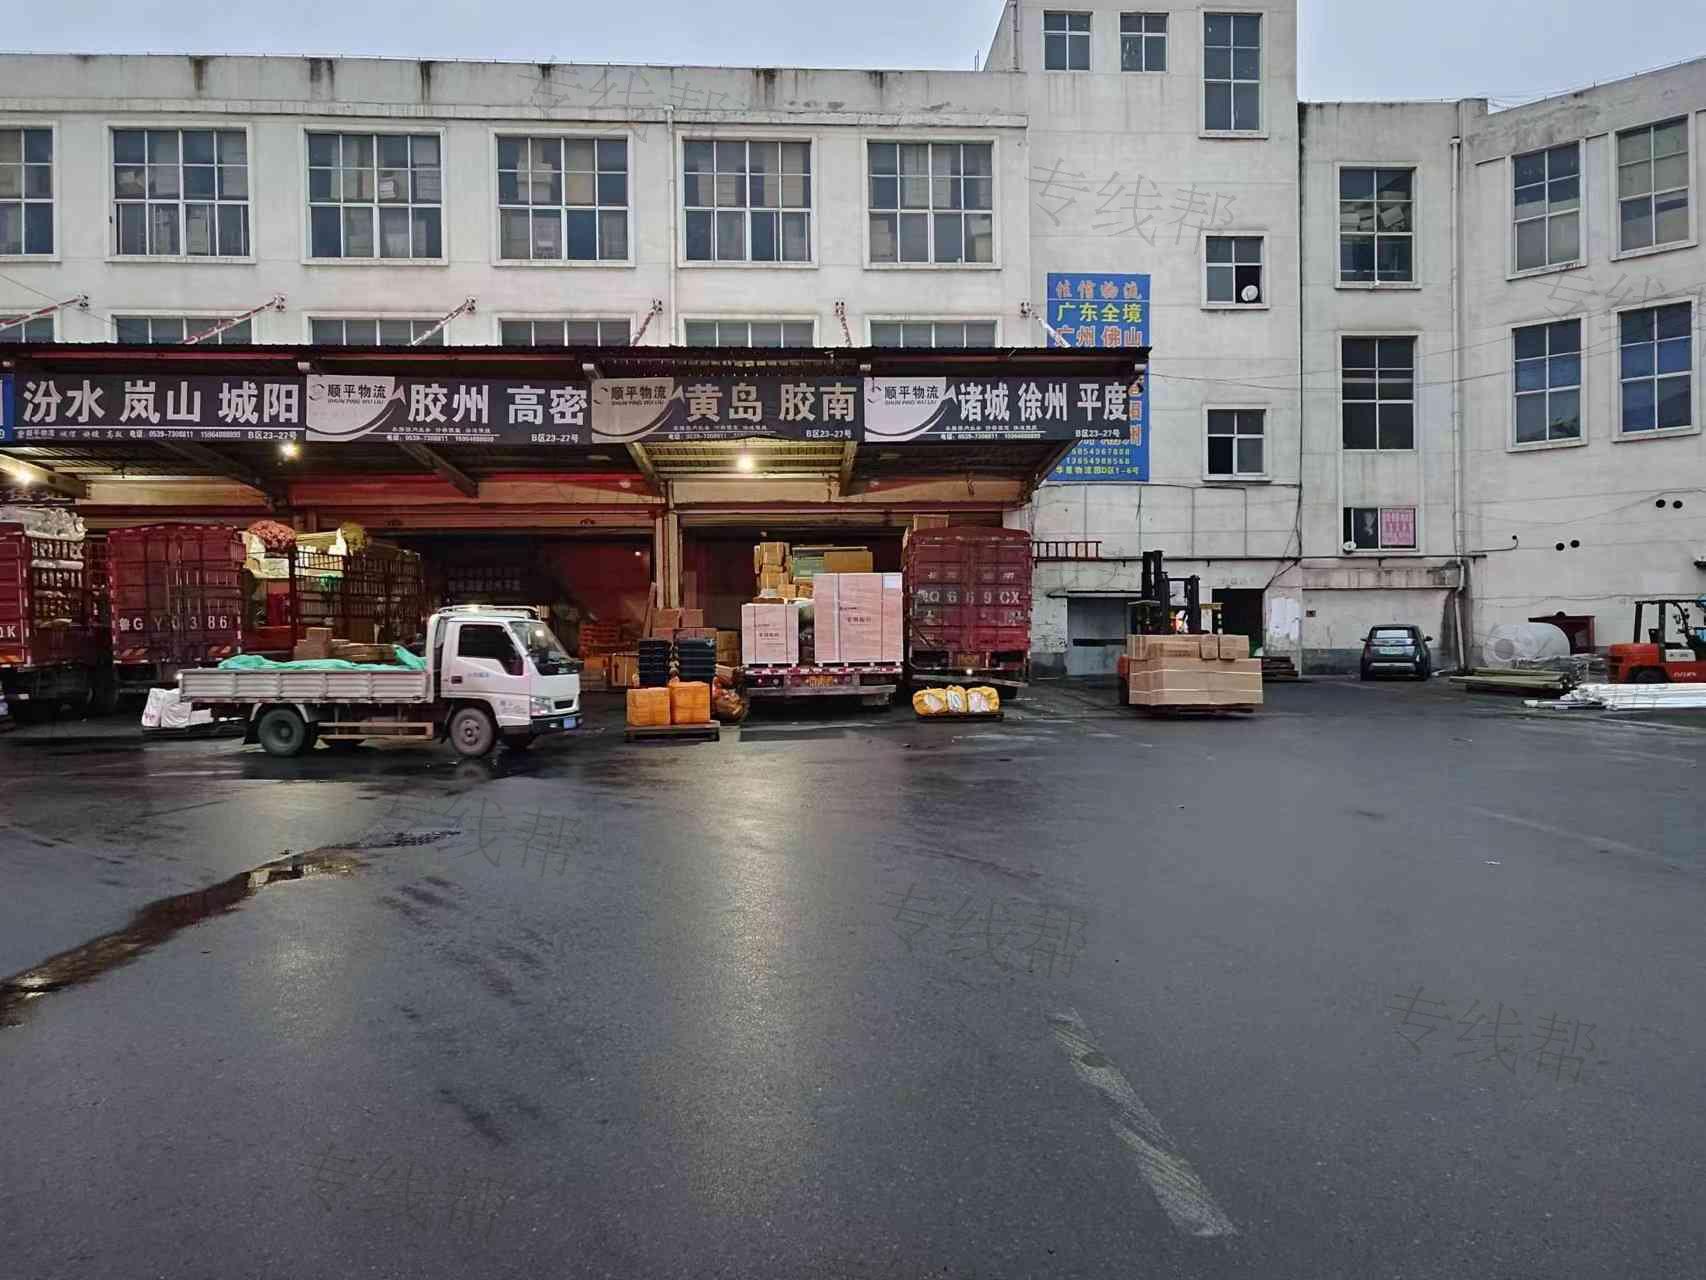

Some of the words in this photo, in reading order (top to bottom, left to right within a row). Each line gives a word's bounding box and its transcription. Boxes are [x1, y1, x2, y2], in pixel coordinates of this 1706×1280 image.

[1057, 302, 1142, 323] 广东全境
[327, 383, 387, 400] 顺平物流
[611, 385, 667, 400] 顺平物流
[884, 385, 940, 400] 顺平物流
[23, 380, 105, 423] 汾水
[119, 380, 203, 423] 岚山
[218, 381, 299, 423] 城阳
[408, 383, 489, 424] 胶州
[506, 384, 588, 425] 高密
[685, 383, 762, 423] 黄岛
[779, 382, 855, 422] 胶南
[958, 382, 1009, 422] 诸城
[1018, 382, 1068, 422] 徐州
[1077, 382, 1128, 421] 平度
[805, 429, 852, 438] B区23-27号
[1075, 429, 1120, 438] B区23-27号
